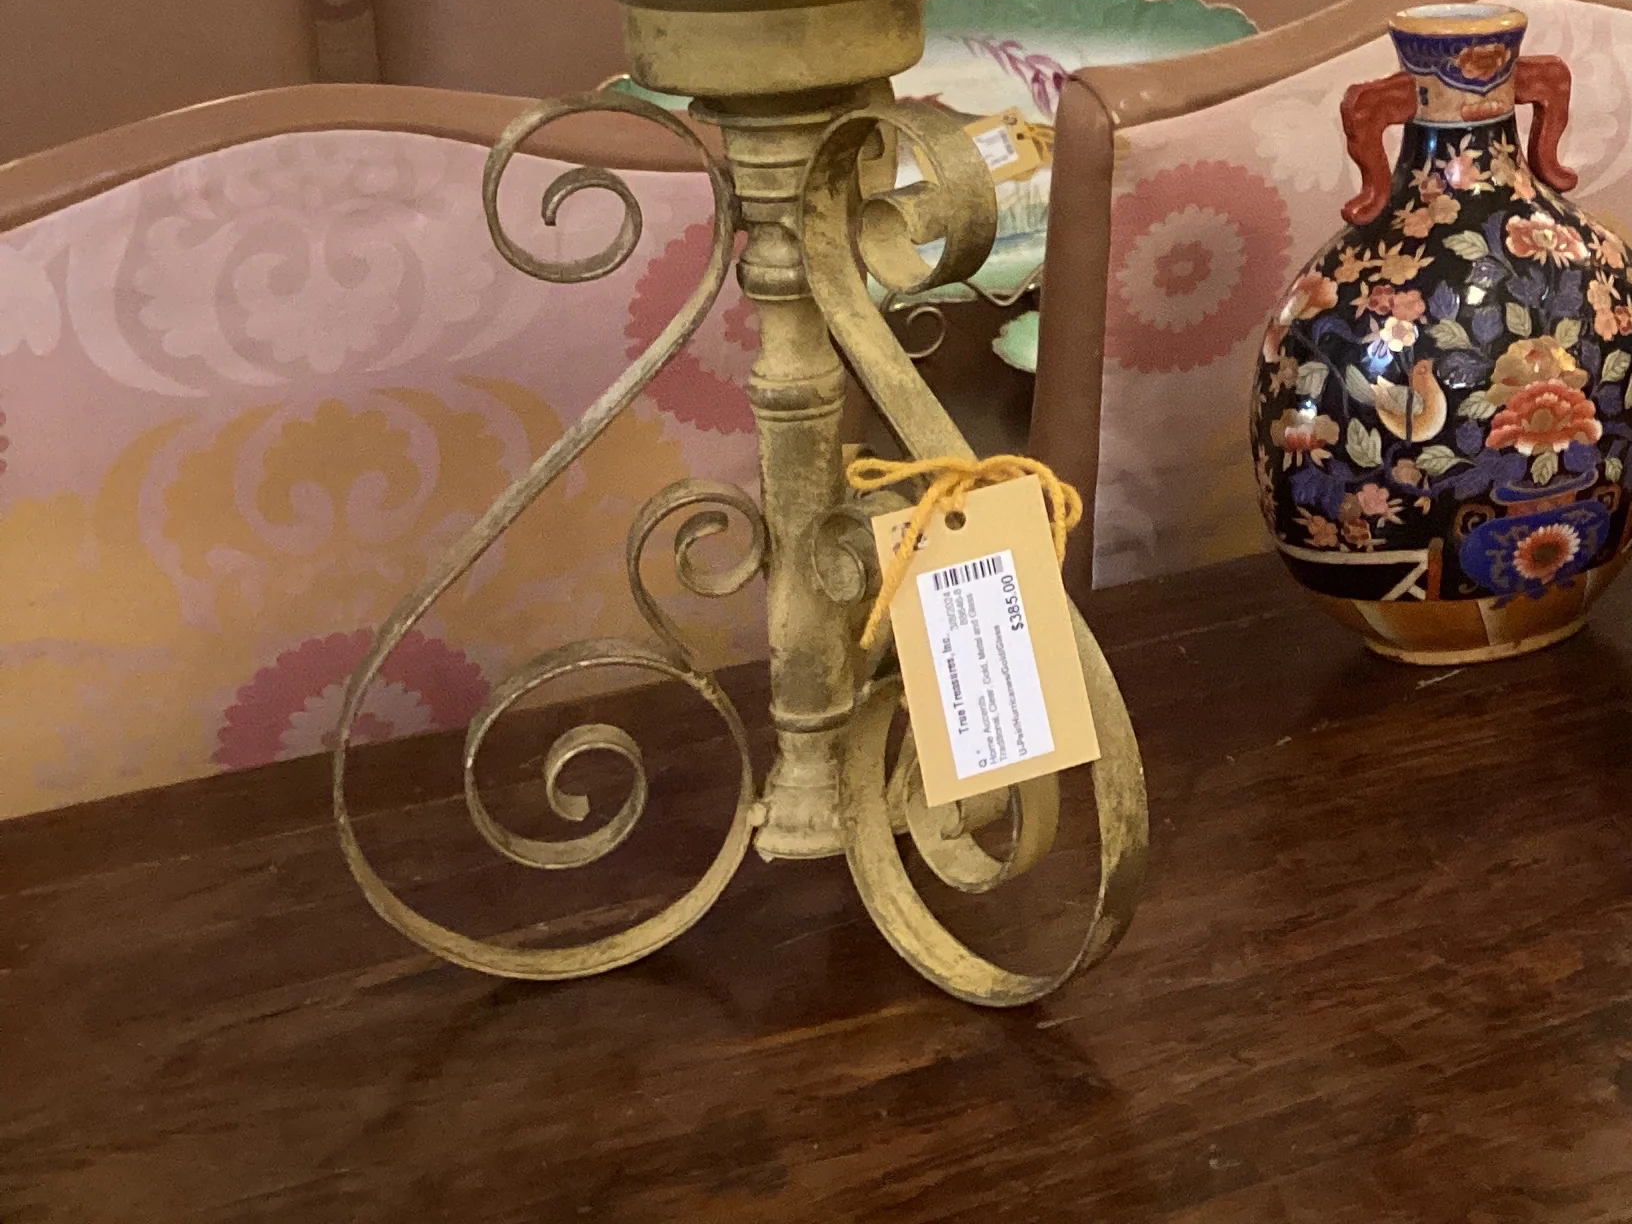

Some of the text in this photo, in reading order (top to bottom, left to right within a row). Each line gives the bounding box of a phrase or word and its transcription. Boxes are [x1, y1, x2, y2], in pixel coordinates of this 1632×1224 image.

[1000, 573, 1024, 631] $385.00
[946, 652, 965, 708] Treasures,
[958, 708, 970, 734] True
[985, 735, 998, 764] Home
